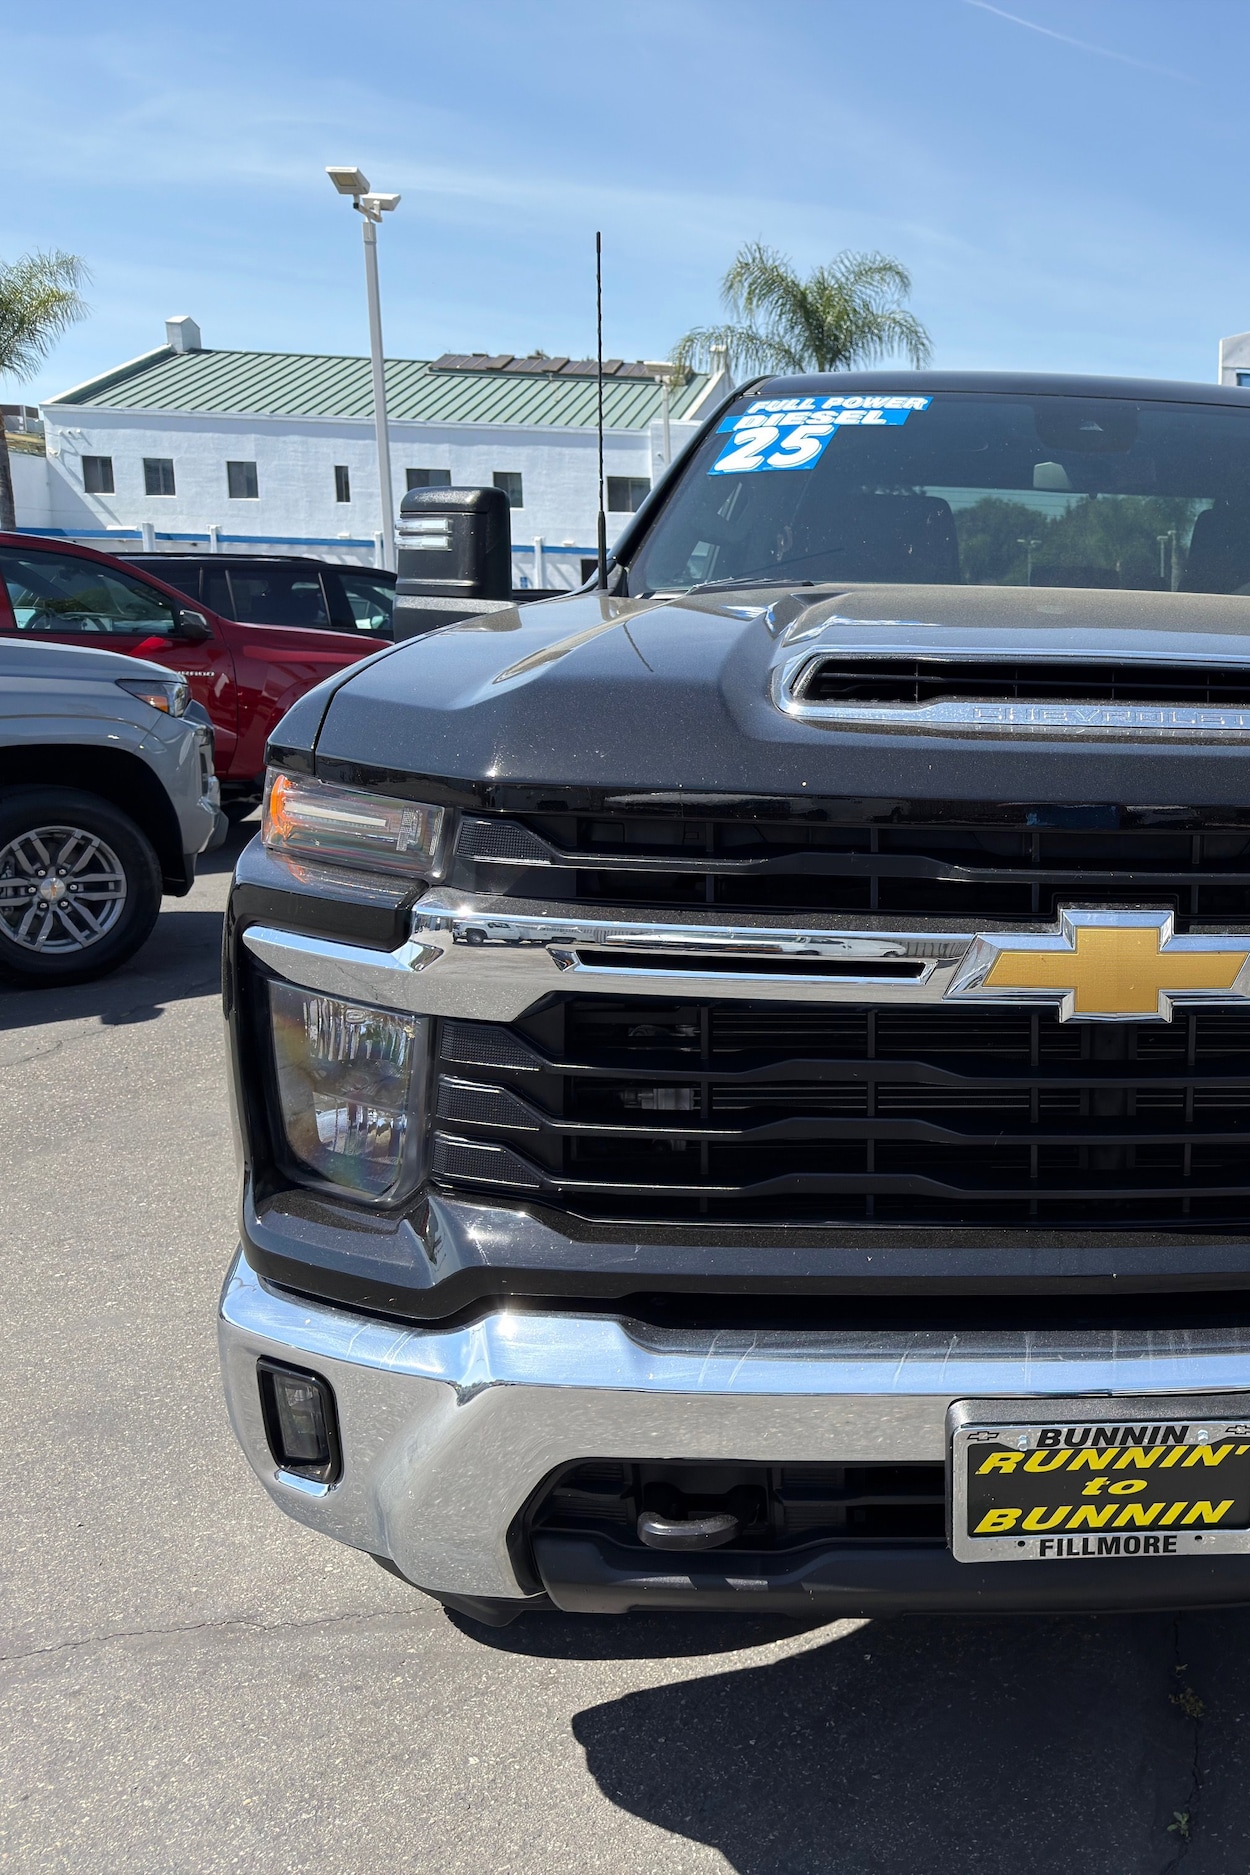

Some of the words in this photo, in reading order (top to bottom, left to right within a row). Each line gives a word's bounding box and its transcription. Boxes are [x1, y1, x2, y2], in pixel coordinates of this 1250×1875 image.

[748, 398, 817, 415] FULL
[820, 396, 929, 410] POWER
[733, 410, 887, 431] DIESEL
[713, 424, 835, 473] 25
[1036, 1426, 1190, 1448] BUNNIN
[975, 1444, 1250, 1475] RUNNIN'
[1081, 1476, 1148, 1496] to
[973, 1499, 1235, 1534] BUNNIN
[1039, 1535, 1178, 1557] FILLMORE
